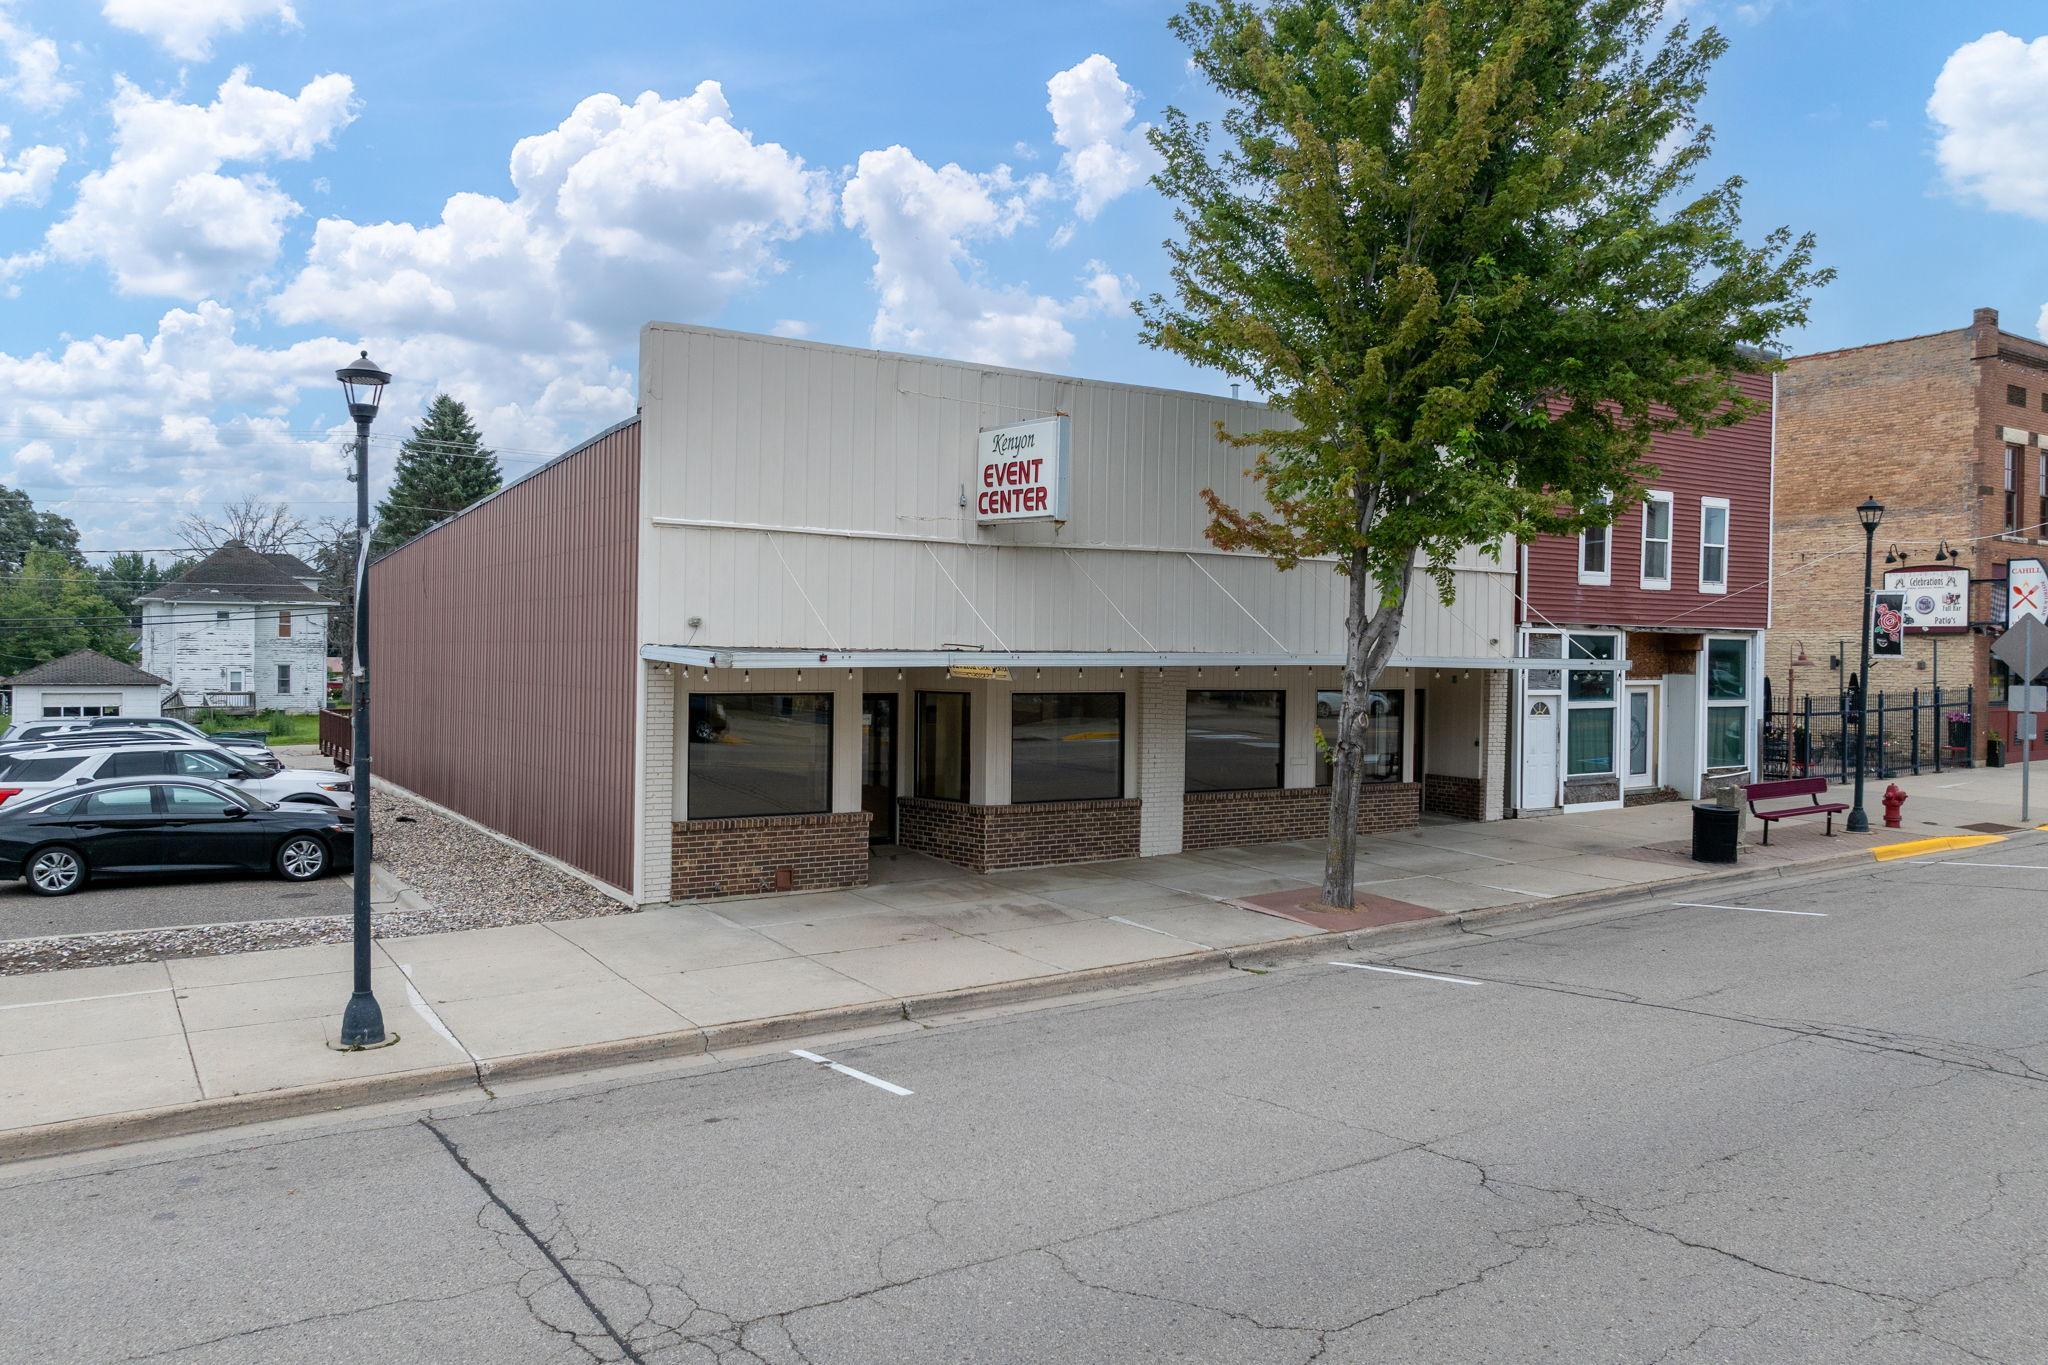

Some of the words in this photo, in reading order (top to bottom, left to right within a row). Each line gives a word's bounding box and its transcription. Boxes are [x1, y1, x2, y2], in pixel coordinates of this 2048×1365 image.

[992, 433, 1036, 458] Kenyon
[983, 458, 1043, 488] EVENT
[978, 486, 1048, 515] CENTER
[1909, 577, 1944, 586] Celebrations
[2012, 567, 2042, 575] CAHILL
